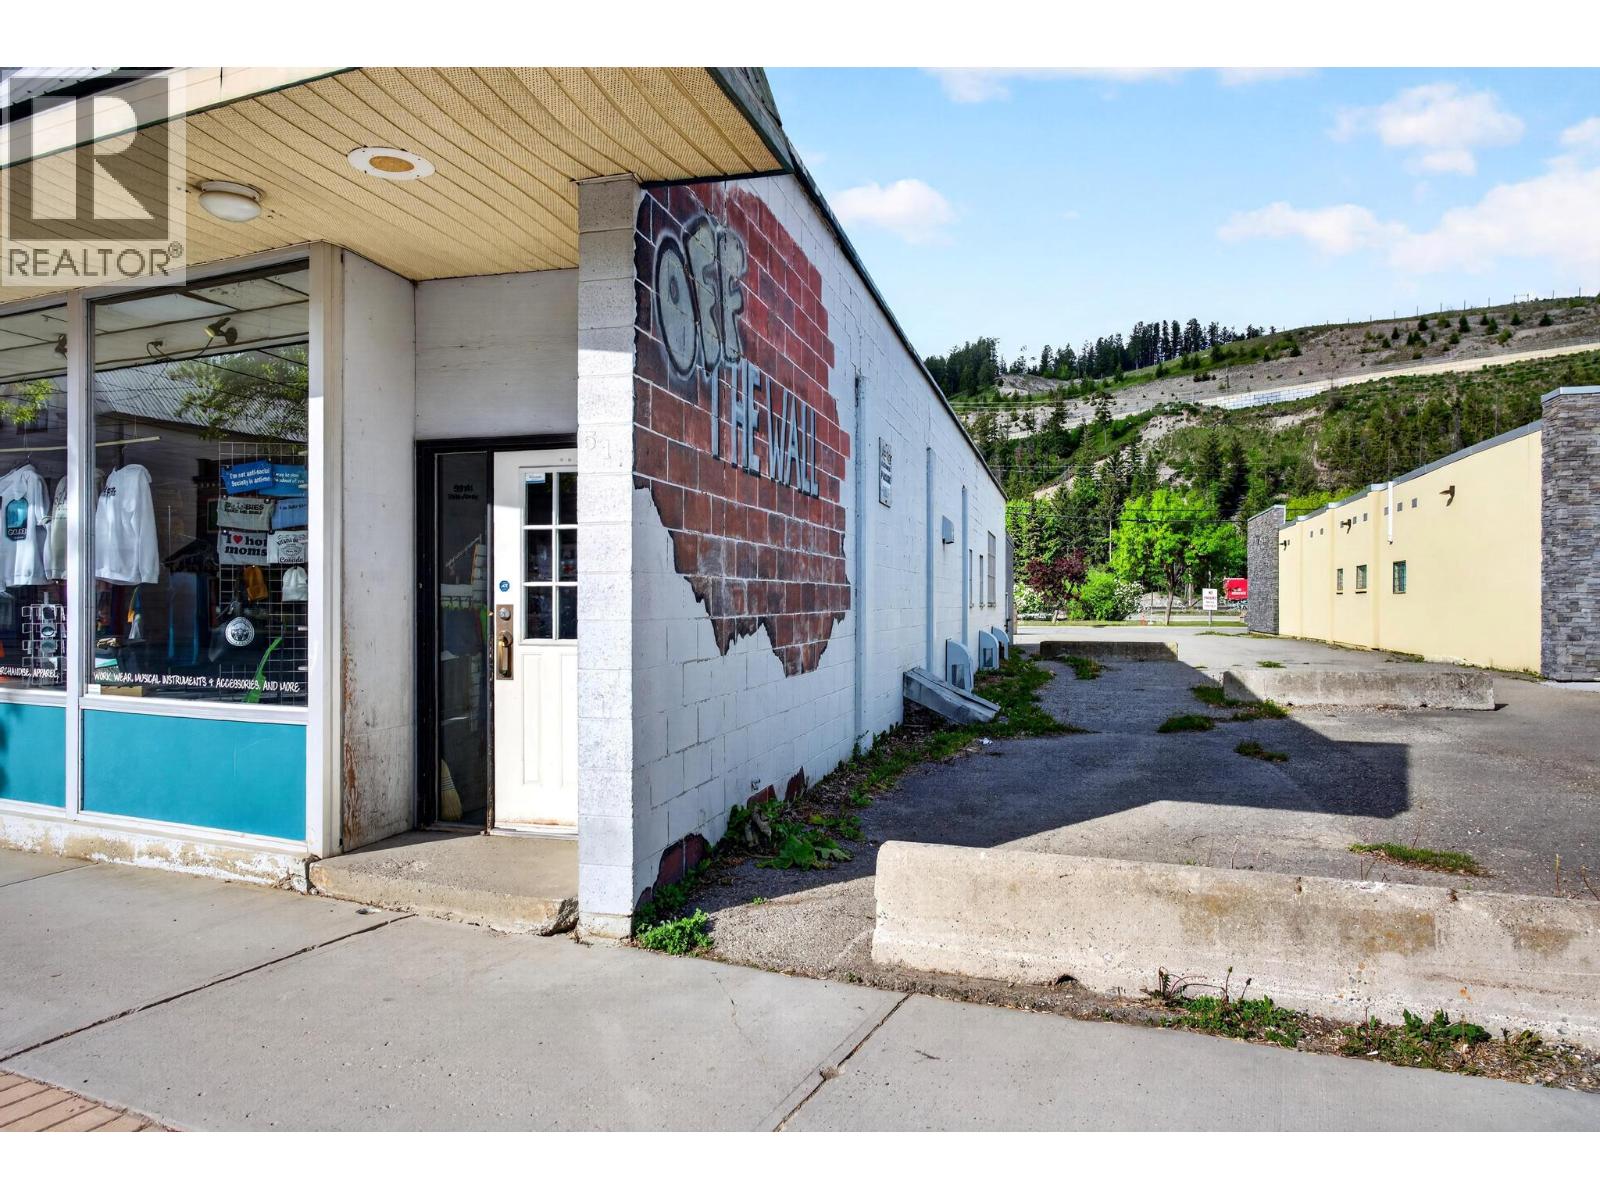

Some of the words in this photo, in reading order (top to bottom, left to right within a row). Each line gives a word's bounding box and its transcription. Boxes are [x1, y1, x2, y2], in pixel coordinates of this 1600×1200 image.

[711, 360, 762, 478] THE
[764, 375, 820, 499] WALL
[225, 534, 232, 544] I
[224, 545, 267, 557] moms
[134, 673, 161, 684] MUSICAL
[162, 675, 207, 687] INSTRUMENTS
[262, 680, 278, 691] AND
[280, 681, 300, 692] MORE
